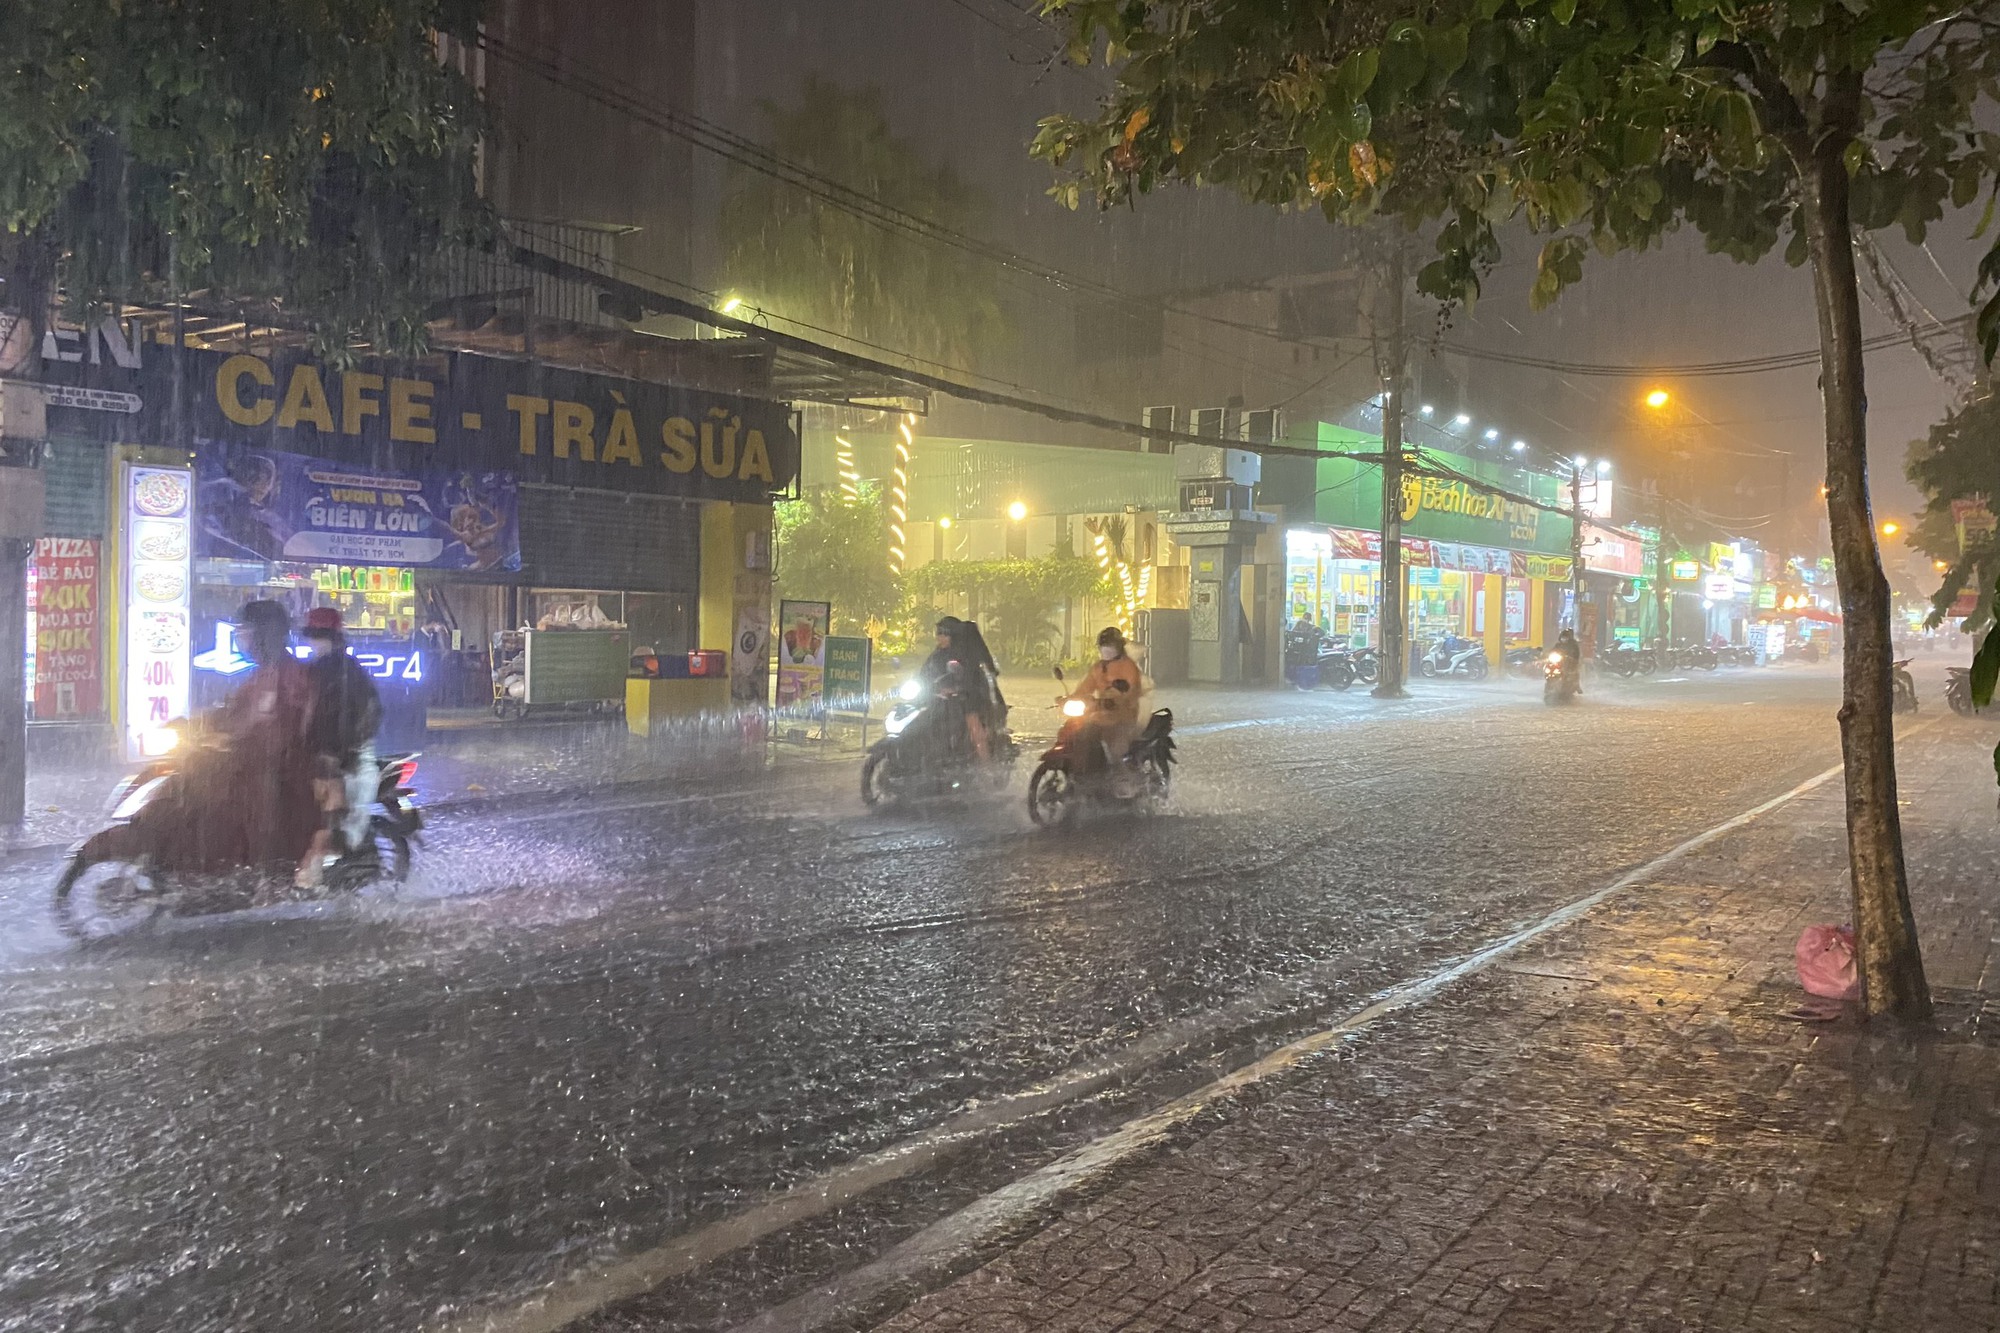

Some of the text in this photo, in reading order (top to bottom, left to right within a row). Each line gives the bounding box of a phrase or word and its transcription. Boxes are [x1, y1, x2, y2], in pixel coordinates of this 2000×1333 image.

[215, 354, 437, 444] CAFE
[506, 390, 643, 467] TRÀ
[661, 406, 773, 483] SỮA
[39, 537, 94, 558] PIZZA
[41, 584, 92, 611] 40K
[38, 628, 92, 653] 90K
[143, 661, 175, 686] 40K
[355, 651, 422, 682] PS4
